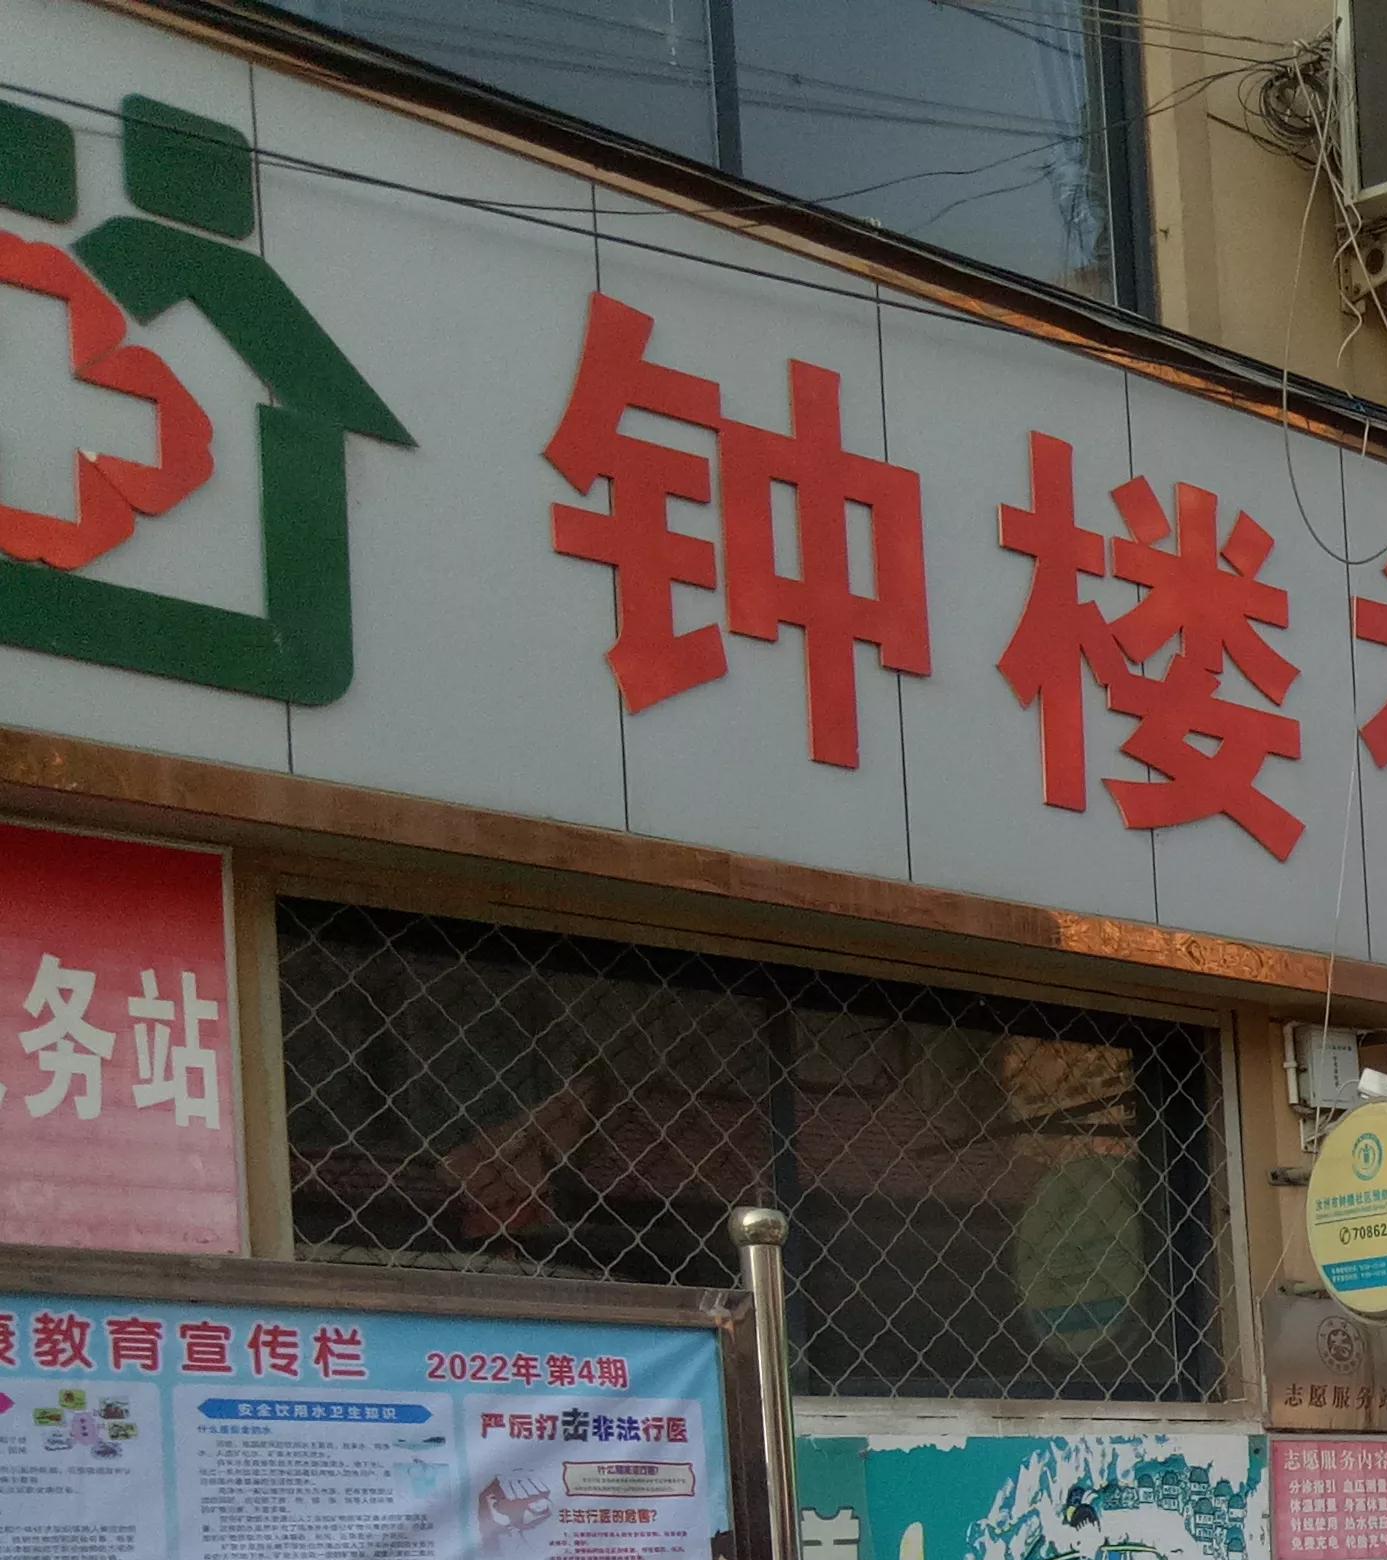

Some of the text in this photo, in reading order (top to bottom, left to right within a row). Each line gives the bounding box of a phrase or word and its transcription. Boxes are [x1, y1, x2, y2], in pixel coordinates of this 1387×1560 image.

[0, 952, 220, 1131] 务站
[0, 1309, 367, 1380] 教育宣传栏
[425, 1351, 630, 1390] 2022年第4期
[237, 1402, 398, 1421] 安全饮用水卫生知识
[480, 1407, 689, 1444] 严厉打击非法行医
[1289, 1480, 1337, 1495] 分诊指引
[1290, 1498, 1338, 1514] 体温测量
[1290, 1516, 1339, 1532] 针线使用
[1291, 1535, 1340, 1551] 免费充电
